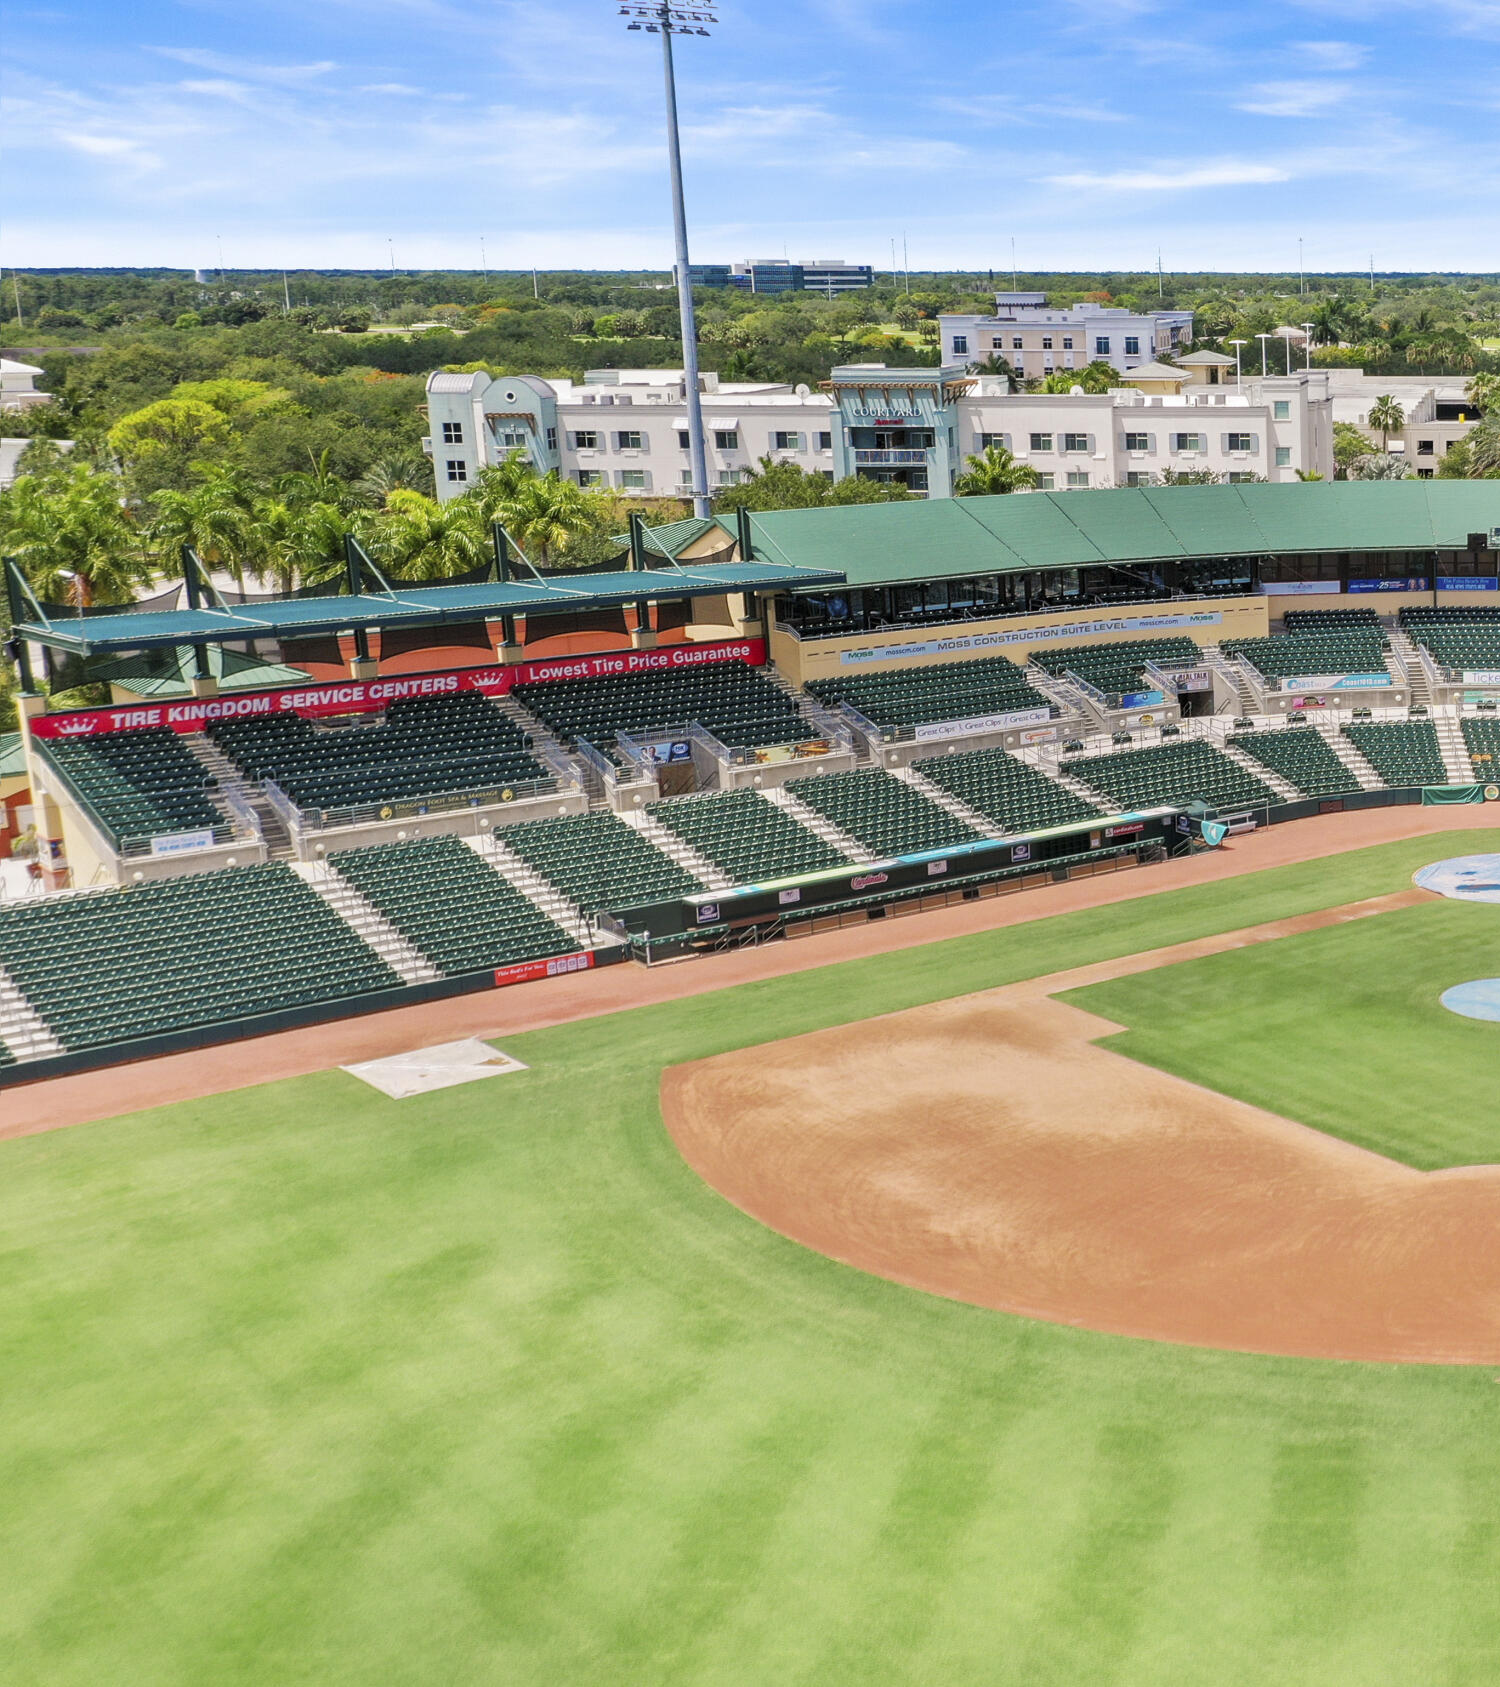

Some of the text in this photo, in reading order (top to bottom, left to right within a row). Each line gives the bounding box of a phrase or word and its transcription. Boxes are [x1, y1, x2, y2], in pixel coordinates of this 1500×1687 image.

[852, 407, 922, 417] COURTYARD
[885, 646, 926, 656] mosscm.com
[937, 639, 971, 651] MOSS
[974, 625, 1059, 646] CONSTRUCTION
[1061, 625, 1091, 636] SUITE
[1093, 621, 1128, 632] LEVEL
[1139, 618, 1179, 627] mosscm.com
[529, 644, 751, 680] Lowest Tire Price Guarantee
[110, 676, 459, 729] TIRE KINGDOM SERVICE CENTERS
[1010, 712, 1047, 724] Great Clips
[965, 719, 1002, 730] Great Clips
[917, 726, 956, 737] Great Clips
